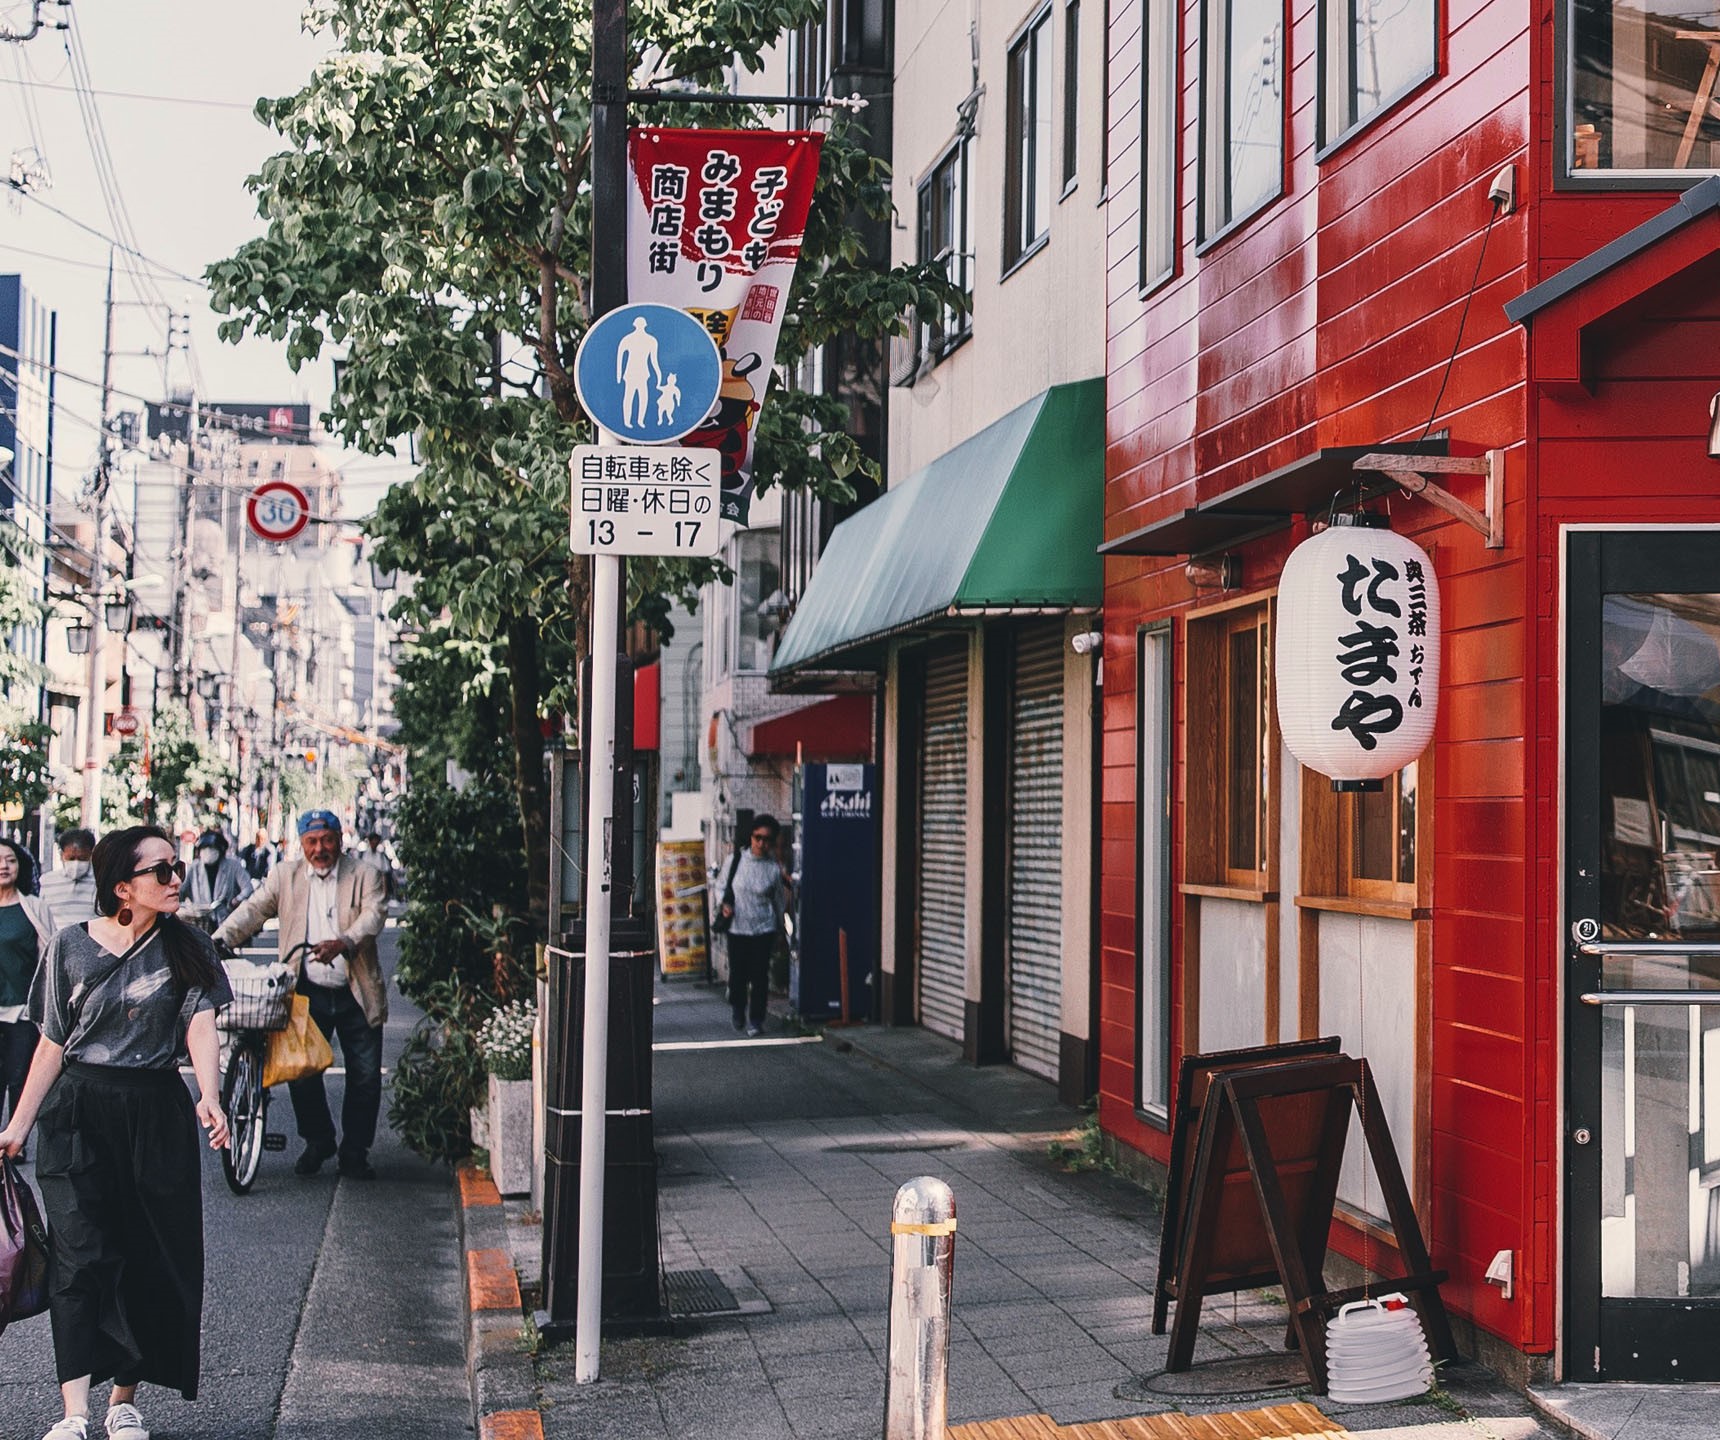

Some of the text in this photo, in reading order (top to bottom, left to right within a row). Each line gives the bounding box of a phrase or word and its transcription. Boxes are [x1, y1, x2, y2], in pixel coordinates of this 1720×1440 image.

[649, 166, 687, 274] 商店街
[697, 153, 738, 292] みまもり
[745, 169, 785, 270] 子ども
[582, 454, 711, 482] 自転車を除く
[261, 499, 295, 524] 30
[589, 520, 615, 545] 13
[675, 521, 701, 547] 17
[1331, 554, 1404, 750] たまや
[820, 790, 871, 812] Asahi
